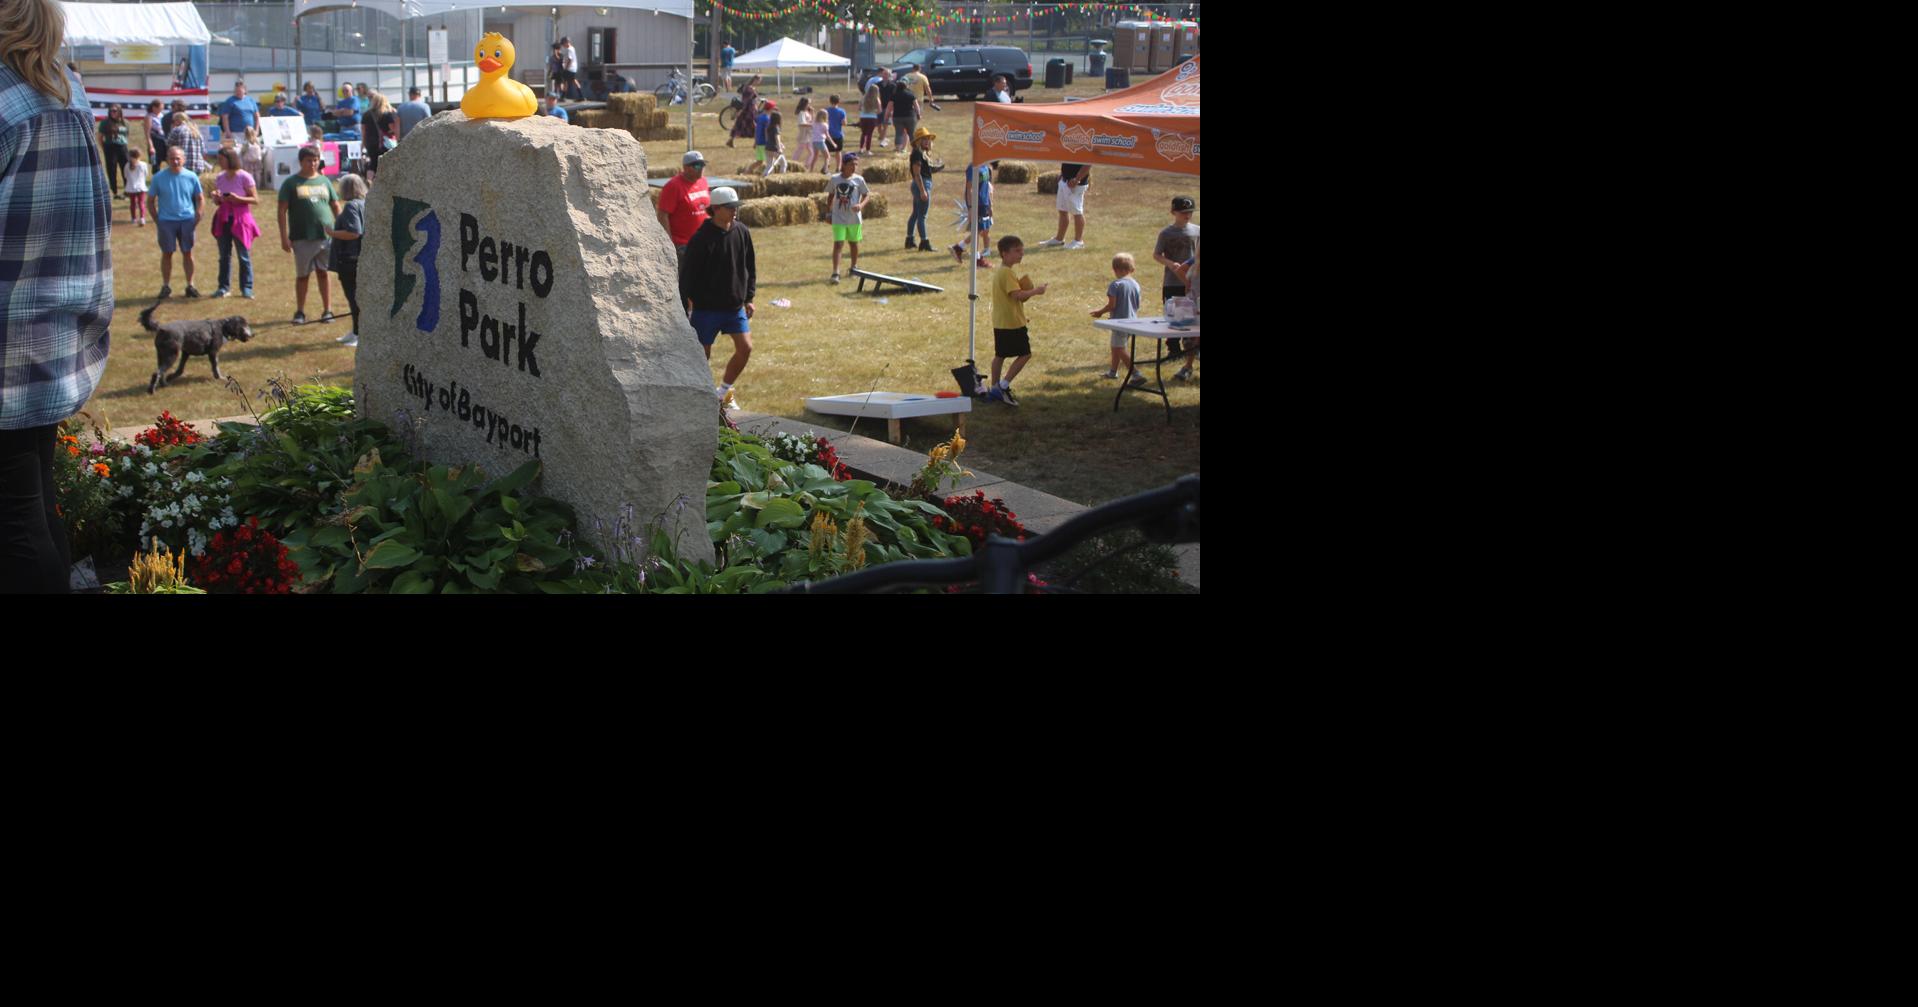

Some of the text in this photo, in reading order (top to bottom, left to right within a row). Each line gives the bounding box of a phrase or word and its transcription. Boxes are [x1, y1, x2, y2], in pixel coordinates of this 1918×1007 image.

[1093, 135, 1110, 144] swim
[1111, 136, 1134, 146] school
[460, 212, 554, 298] Perro
[459, 287, 541, 377] Park
[403, 363, 541, 457] City of Bayport
